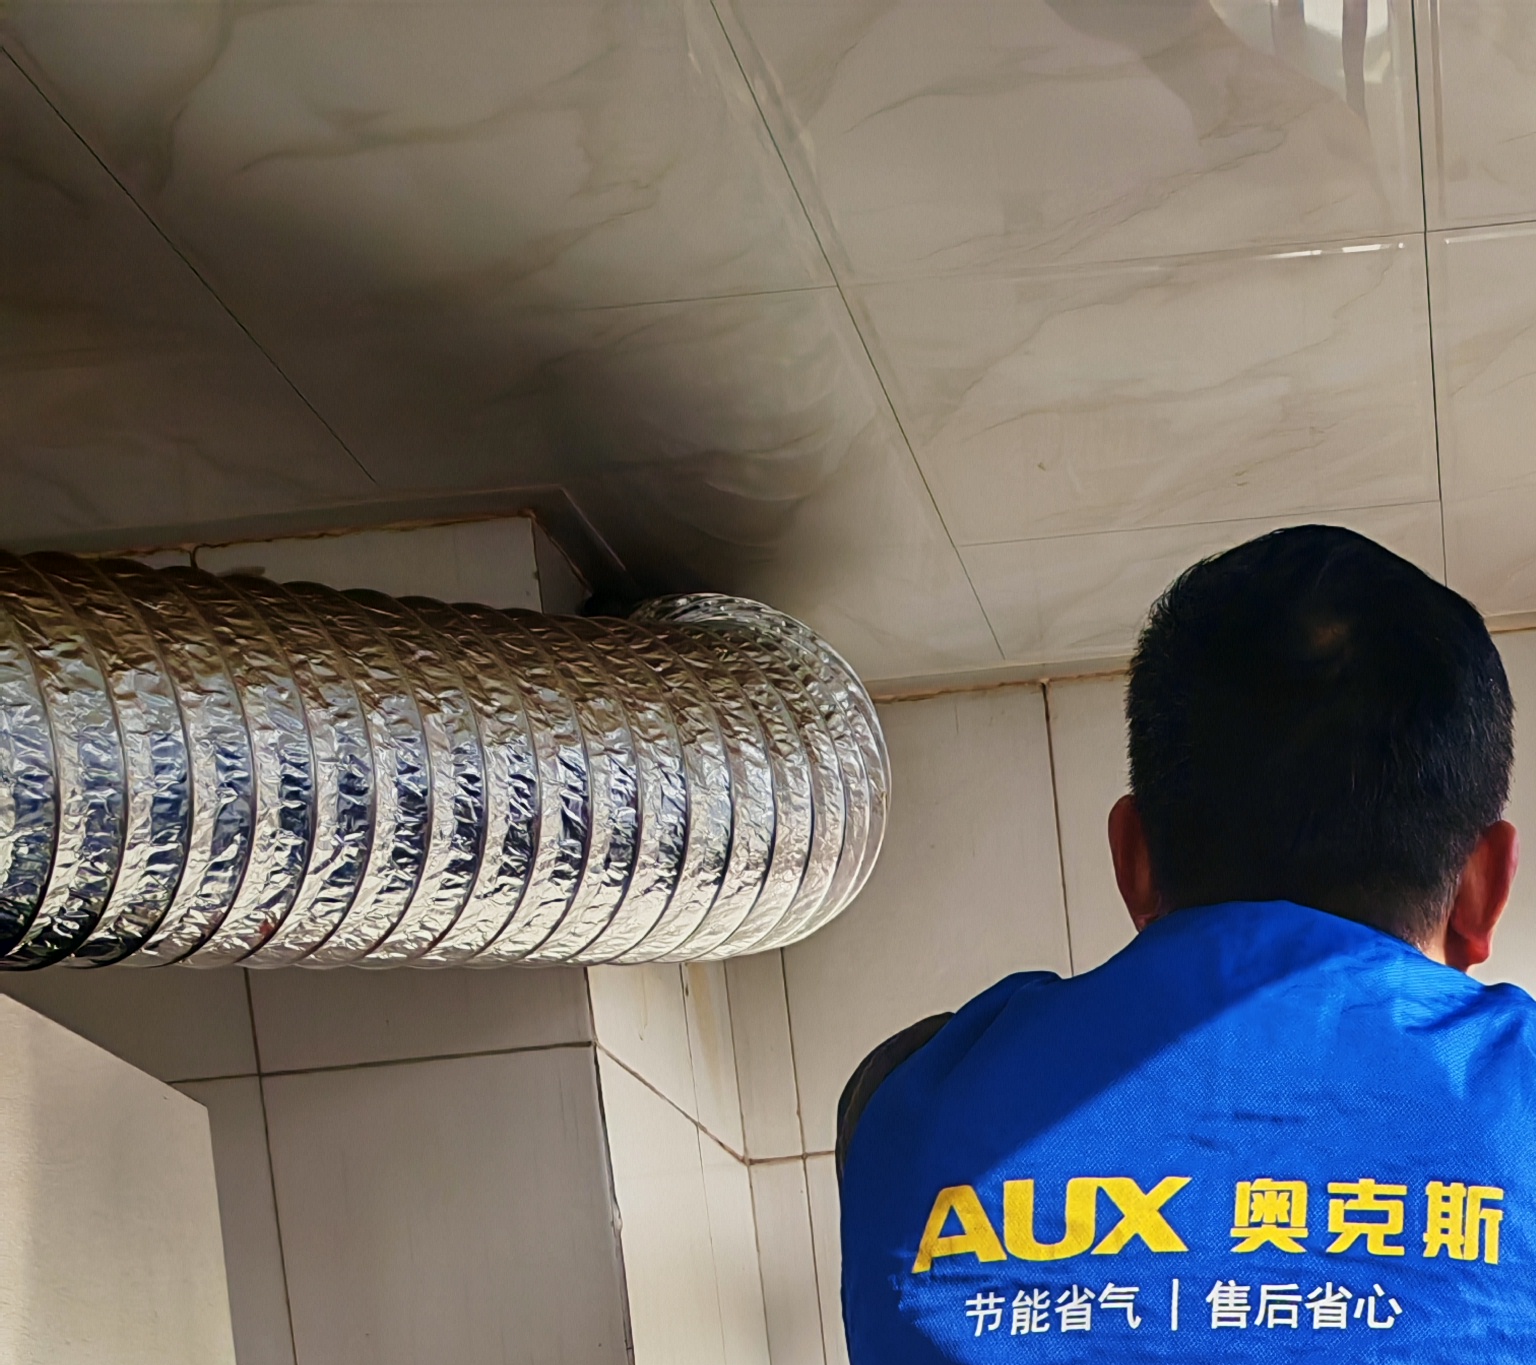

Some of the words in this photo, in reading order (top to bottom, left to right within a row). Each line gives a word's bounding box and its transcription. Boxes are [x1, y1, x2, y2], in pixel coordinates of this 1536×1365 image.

[911, 1176, 1193, 1273] AUX
[1230, 1178, 1505, 1265] 奥克斯
[965, 1283, 1142, 1337] 节能省气
[1205, 1281, 1403, 1330] 售后省心
